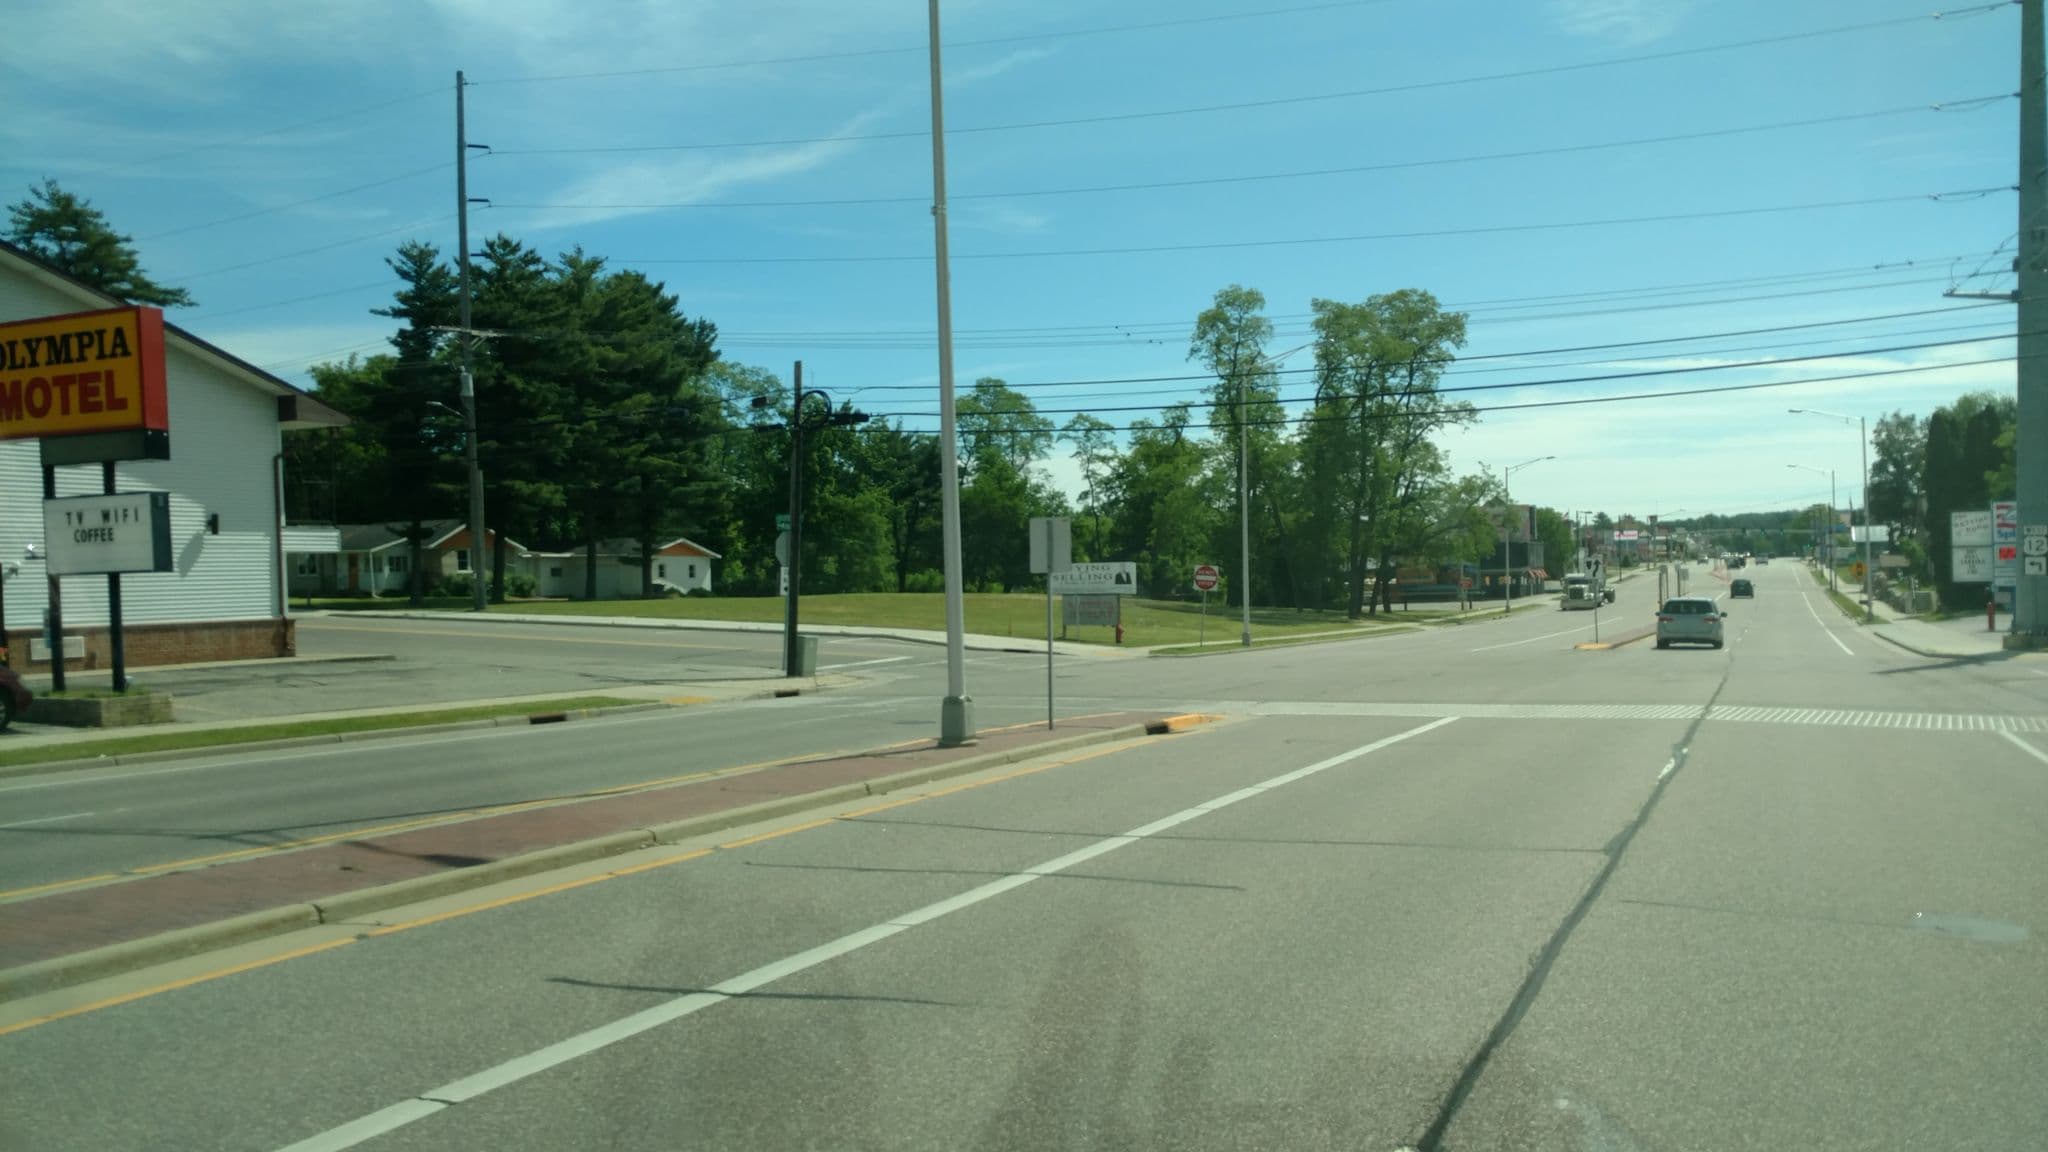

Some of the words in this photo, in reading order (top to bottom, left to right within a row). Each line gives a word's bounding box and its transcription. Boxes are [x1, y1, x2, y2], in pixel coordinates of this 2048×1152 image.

[0, 369, 129, 422] MOTEL
[101, 507, 139, 524] WIFI
[74, 527, 115, 543] COFFEE
[2029, 540, 2045, 551] 12
[1052, 573, 1113, 581] SELLING
